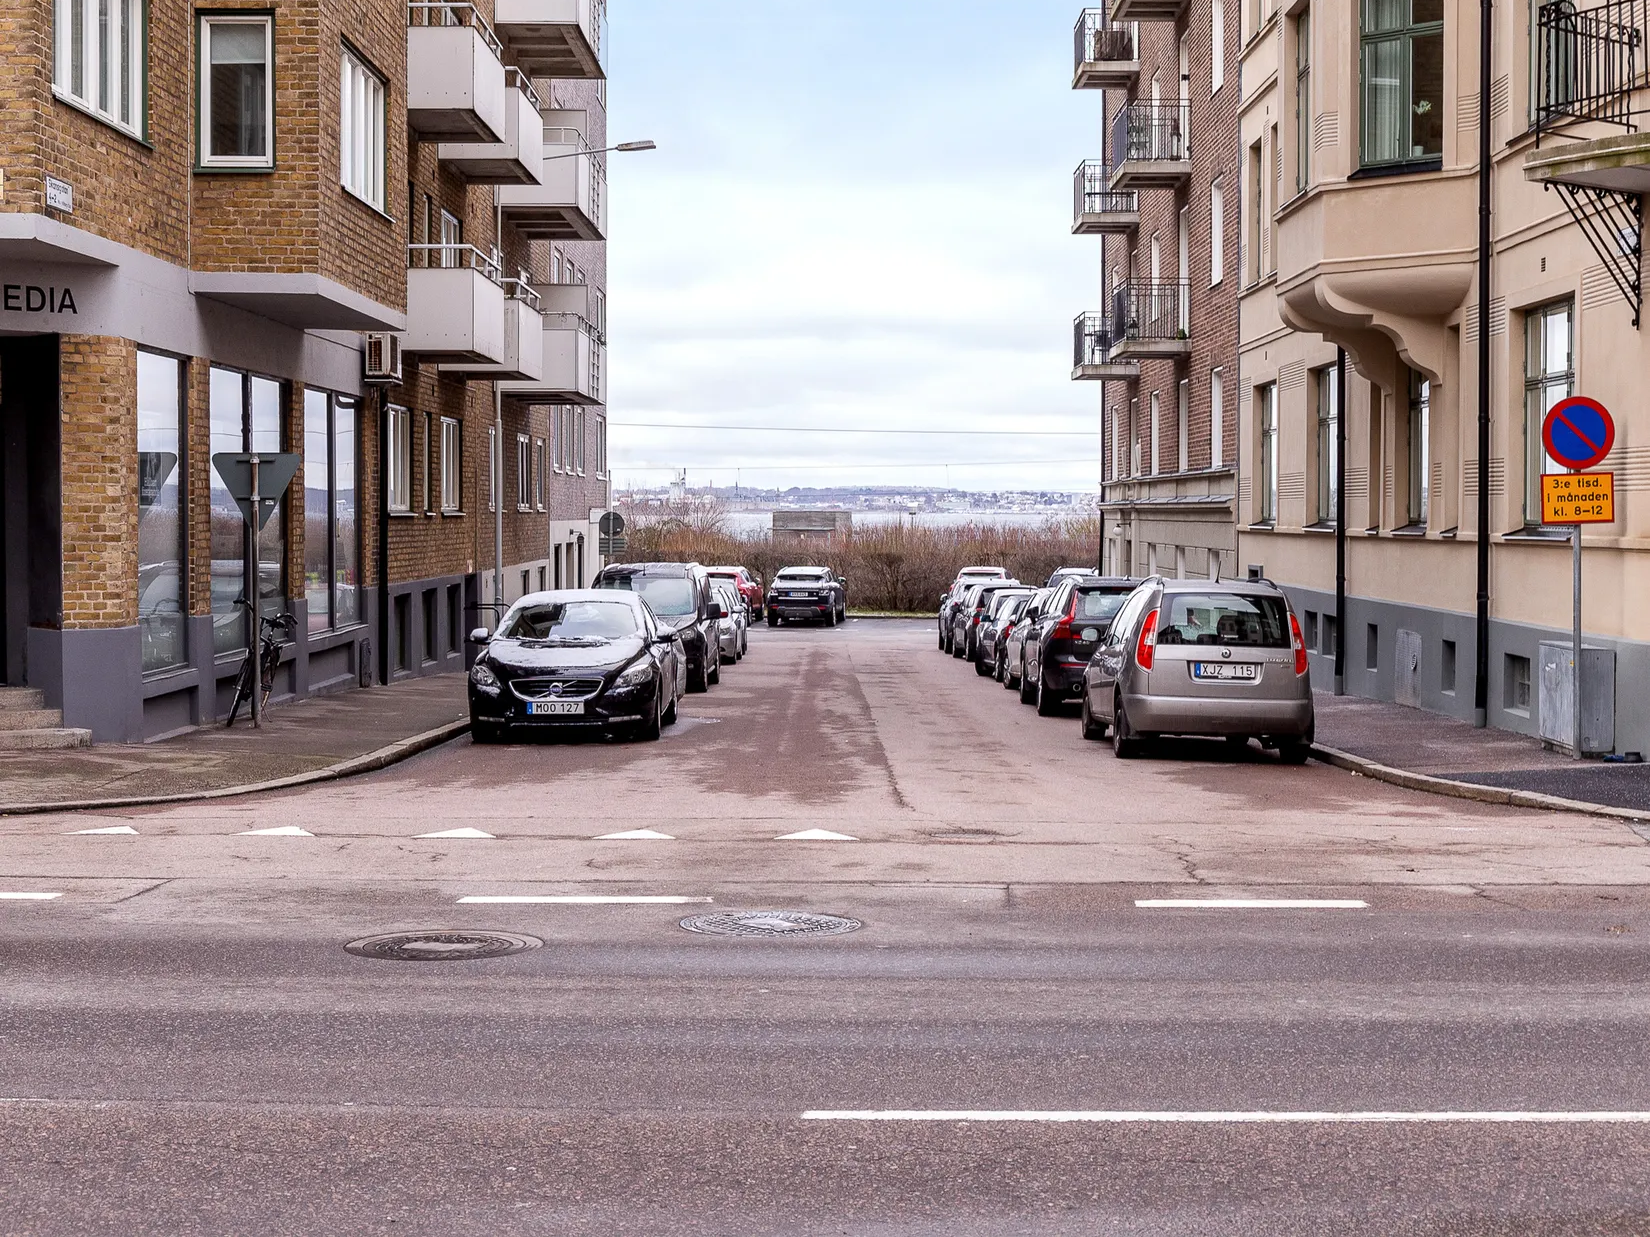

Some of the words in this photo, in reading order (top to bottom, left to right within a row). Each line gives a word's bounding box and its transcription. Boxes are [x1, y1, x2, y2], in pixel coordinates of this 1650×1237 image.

[3, 284, 78, 314] EDIA
[1552, 479, 1571, 489] 3:e
[1577, 477, 1602, 488] tisd.
[1547, 493, 1550, 503] i
[1556, 492, 1609, 503] månaden
[1553, 506, 1567, 517] kl.
[1202, 665, 1223, 675] XJZ
[1233, 665, 1253, 676] 115
[560, 703, 580, 713] 127
